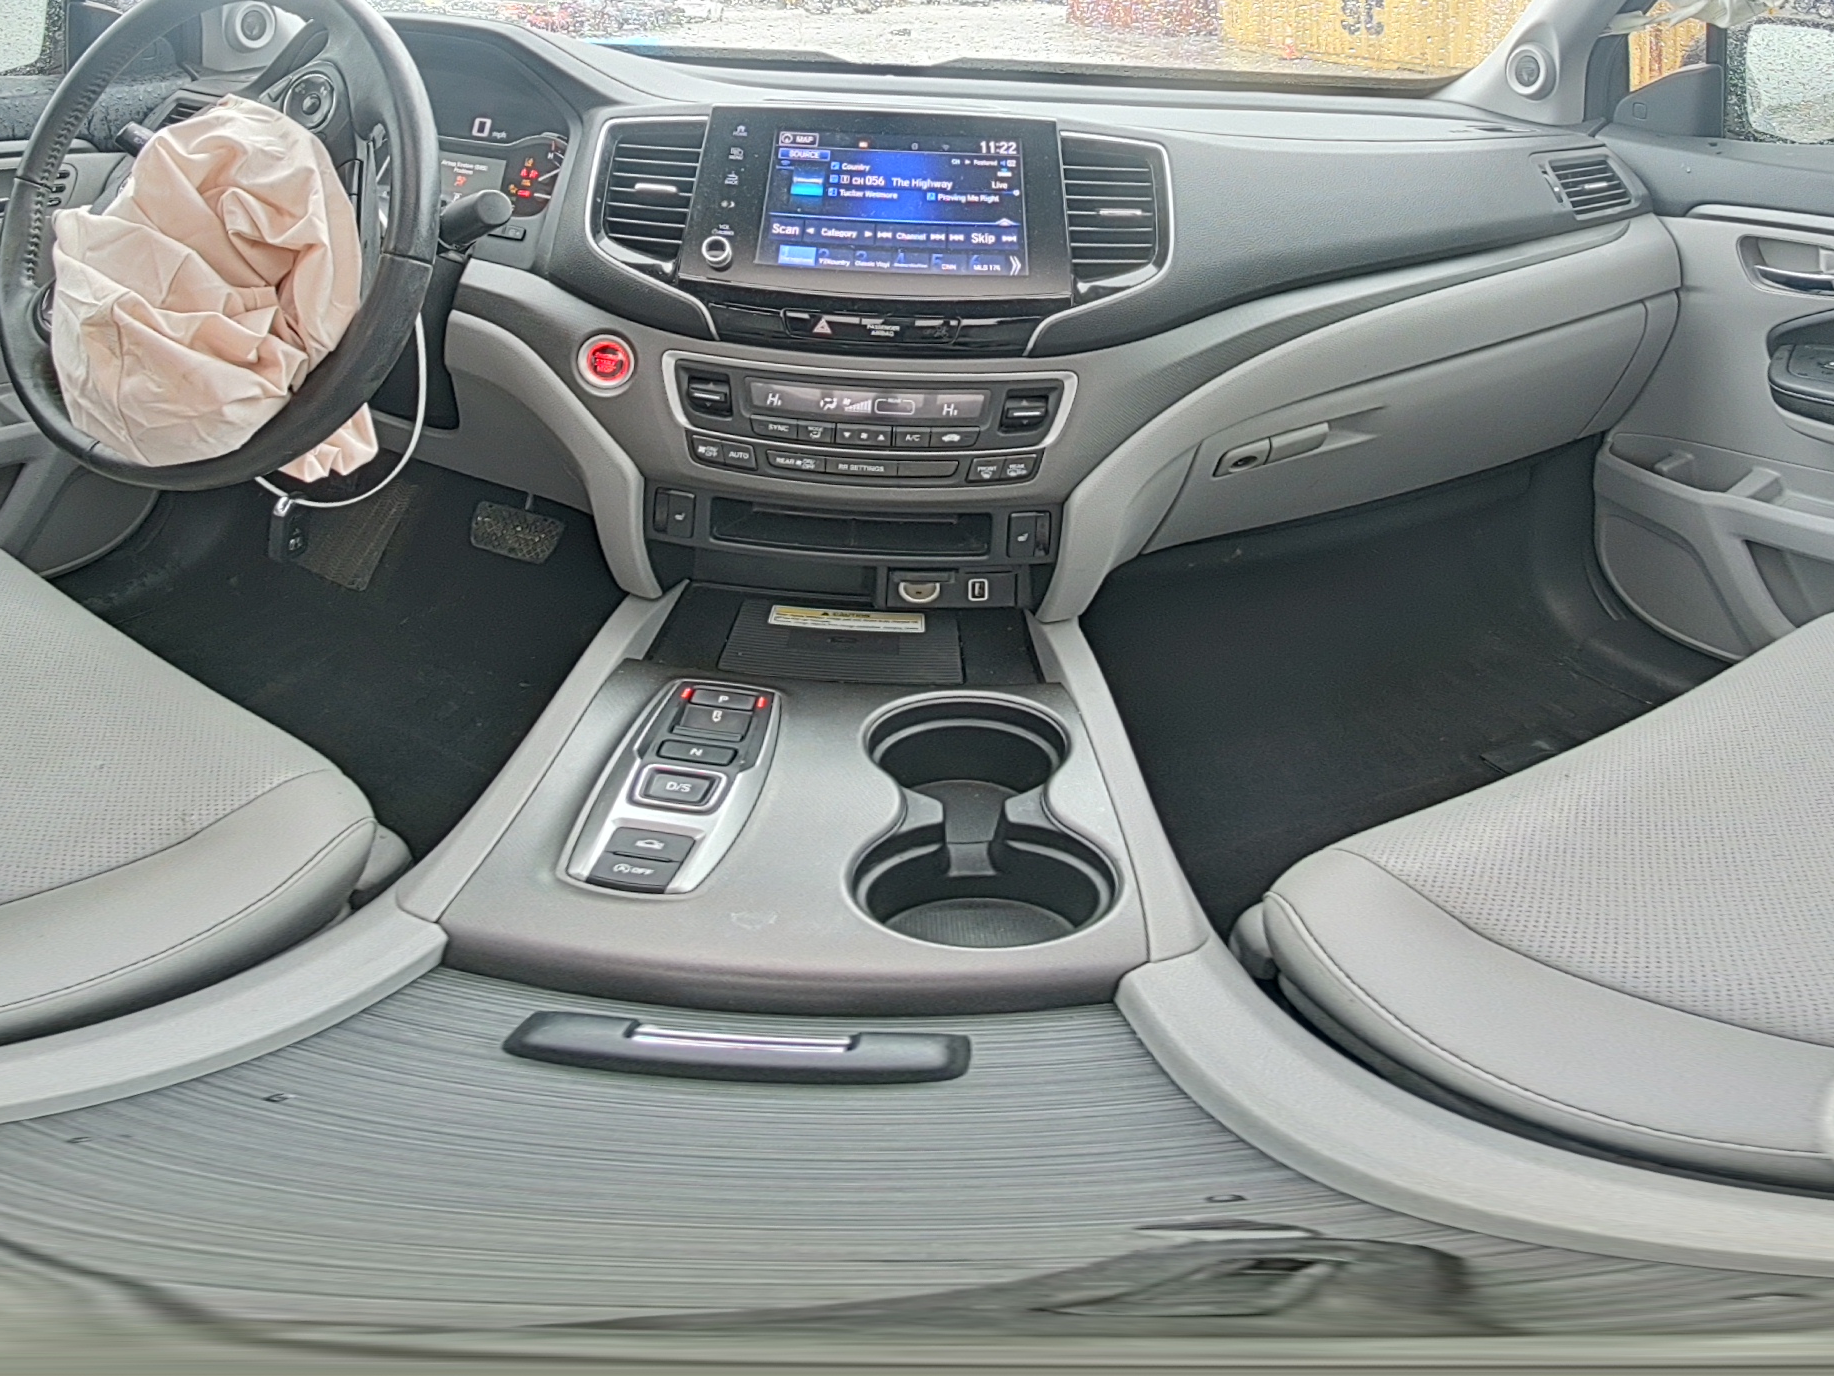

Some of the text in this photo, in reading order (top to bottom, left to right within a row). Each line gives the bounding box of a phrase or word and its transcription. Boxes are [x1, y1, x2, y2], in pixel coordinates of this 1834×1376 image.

[795, 135, 814, 144] MAP
[980, 140, 1017, 155] 11:22
[789, 150, 820, 159] SOURCE
[842, 163, 871, 172] Country
[852, 175, 953, 190] CH 056 The Highway
[991, 180, 1008, 190] Live
[937, 193, 966, 203] Proving
[980, 194, 1000, 204] Right
[772, 222, 800, 236] Scan
[821, 227, 857, 239] Category
[896, 232, 926, 241] Channel
[971, 232, 996, 245] Skip
[768, 423, 790, 433] SYNC
[905, 433, 921, 442] A/C
[728, 451, 750, 460] AUTO
[776, 457, 795, 465] REAR
[849, 465, 885, 473] SETTINGS
[718, 695, 729, 703] P
[689, 747, 703, 757] N
[665, 781, 691, 793] D/S
[631, 866, 655, 876] OFF
